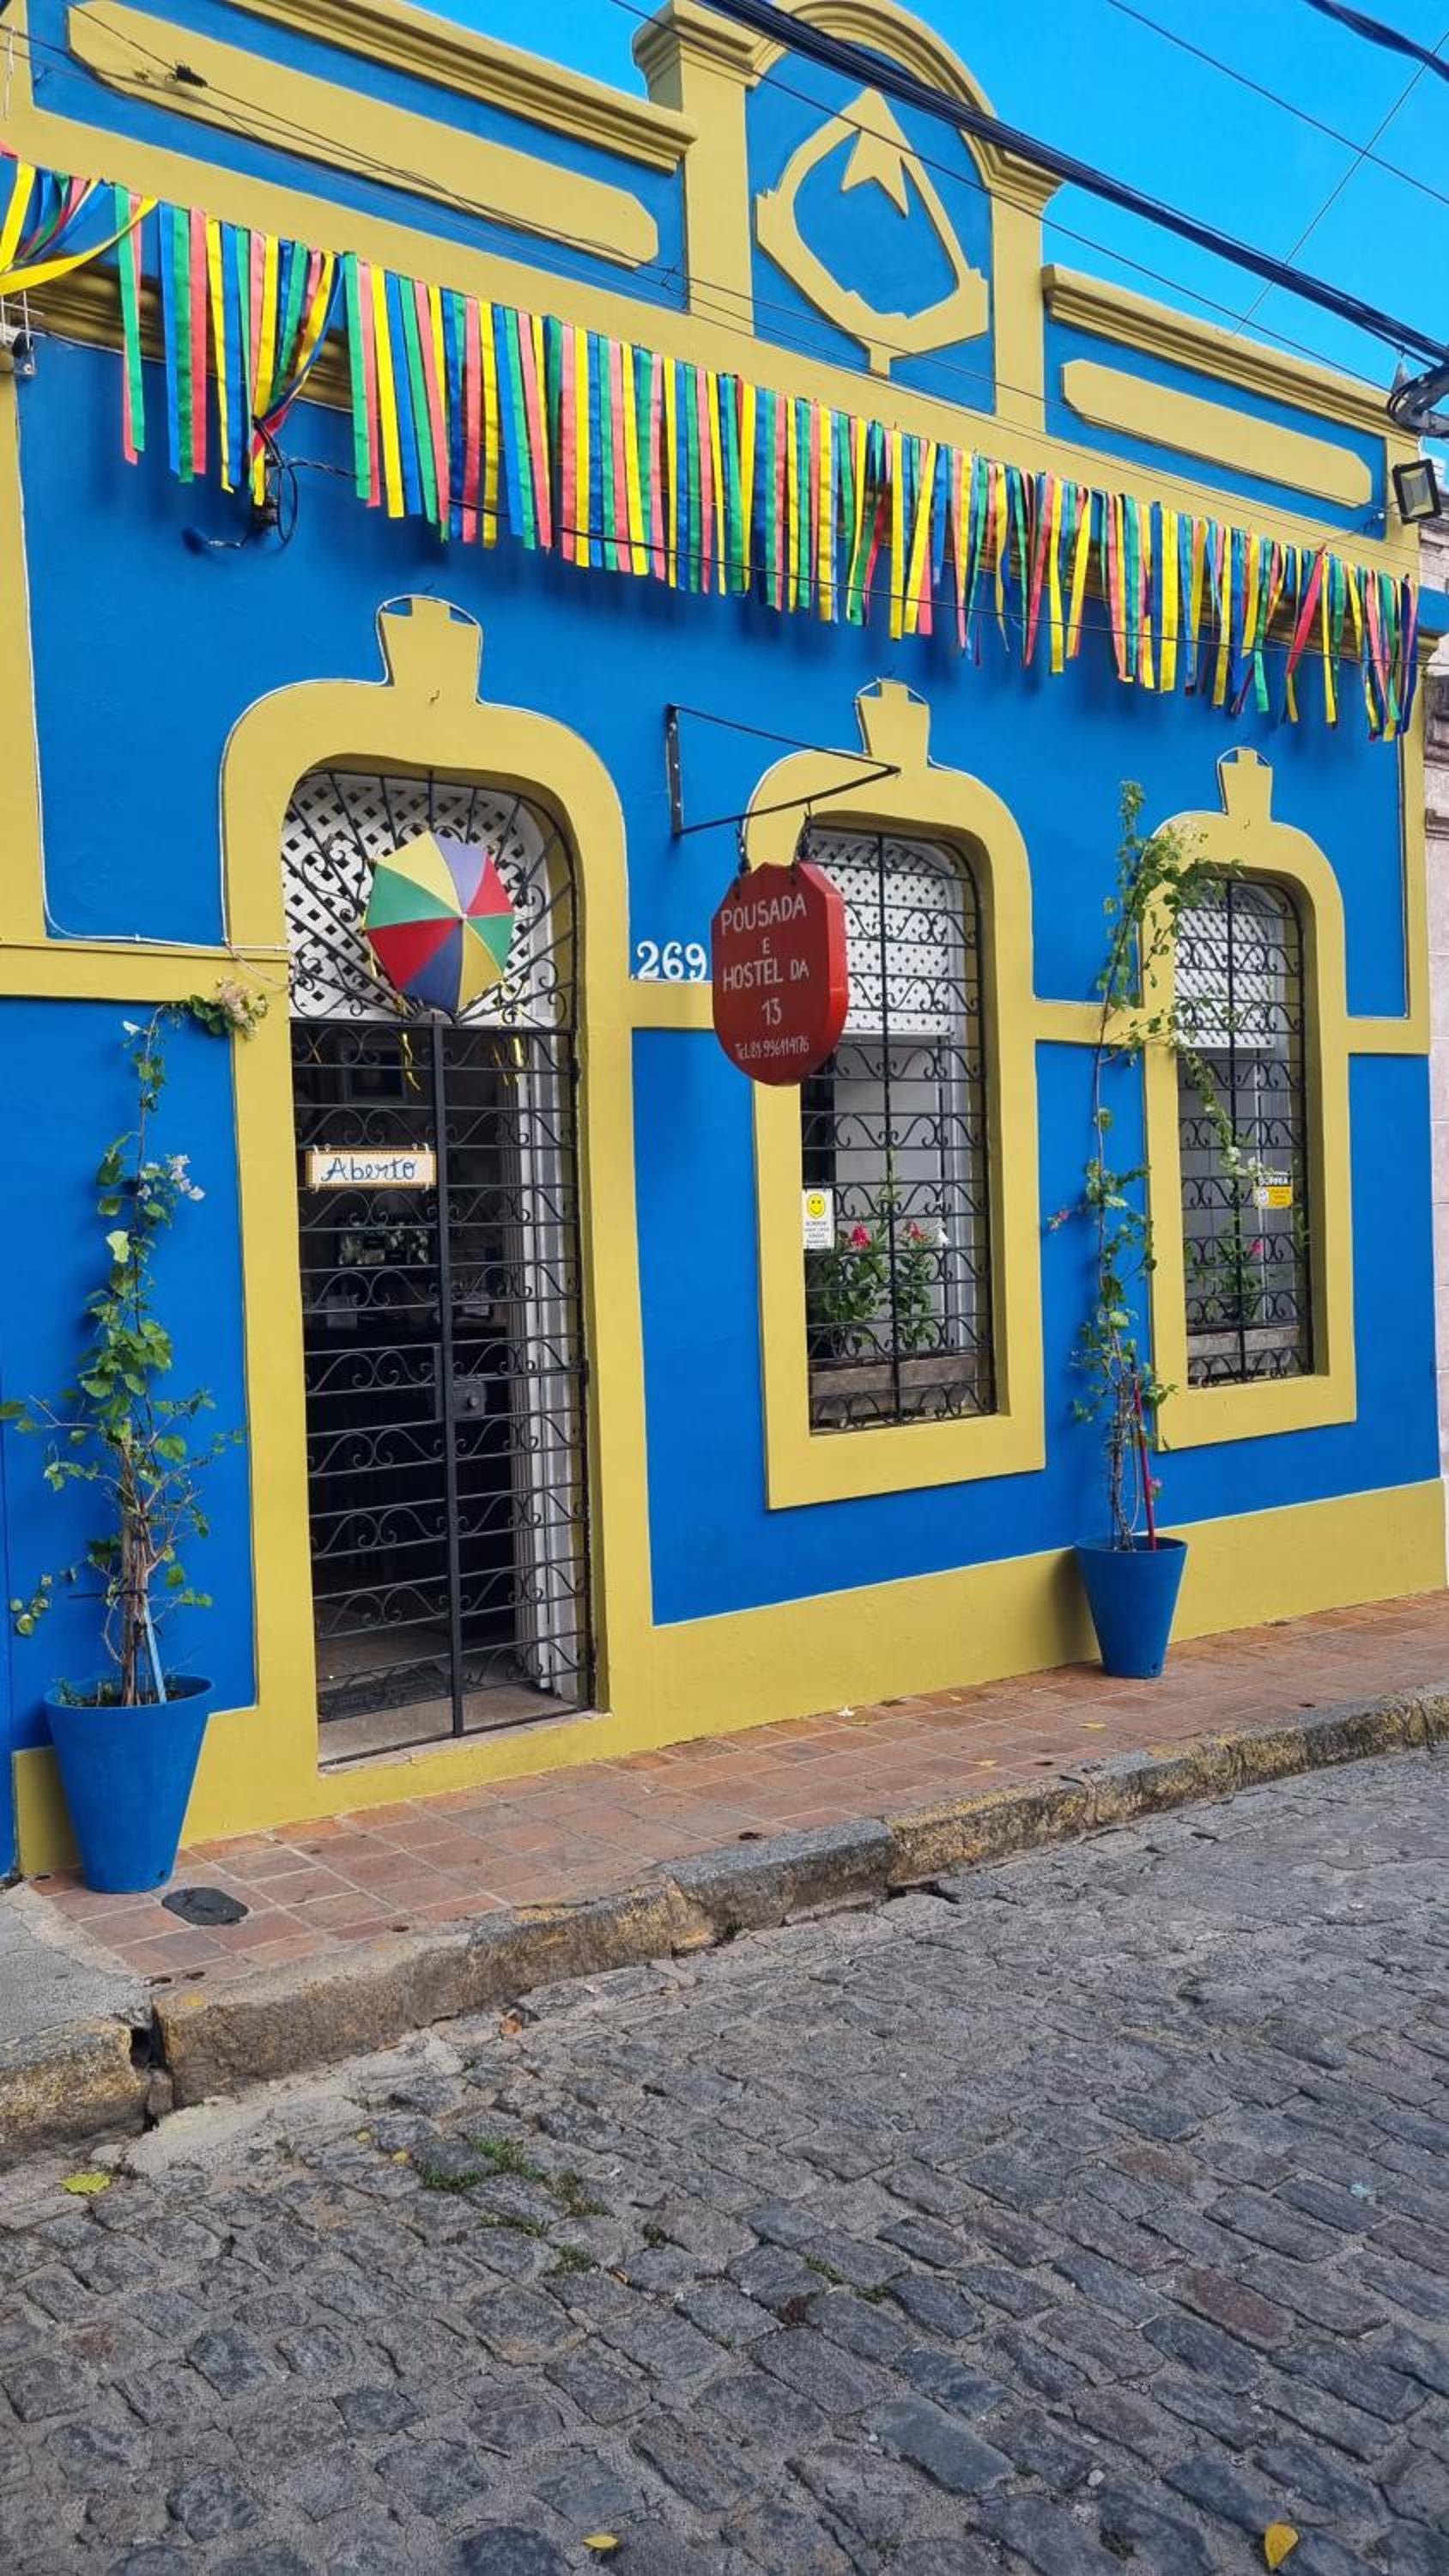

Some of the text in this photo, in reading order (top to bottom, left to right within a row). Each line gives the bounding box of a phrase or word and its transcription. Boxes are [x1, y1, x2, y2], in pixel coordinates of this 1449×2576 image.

[721, 893, 807, 936] POUSADA
[637, 940, 707, 981] 269
[762, 937, 770, 954] E
[723, 958, 809, 992] HOSTEL DA
[761, 997, 782, 1026] 13
[320, 1157, 418, 1182] Aberto
